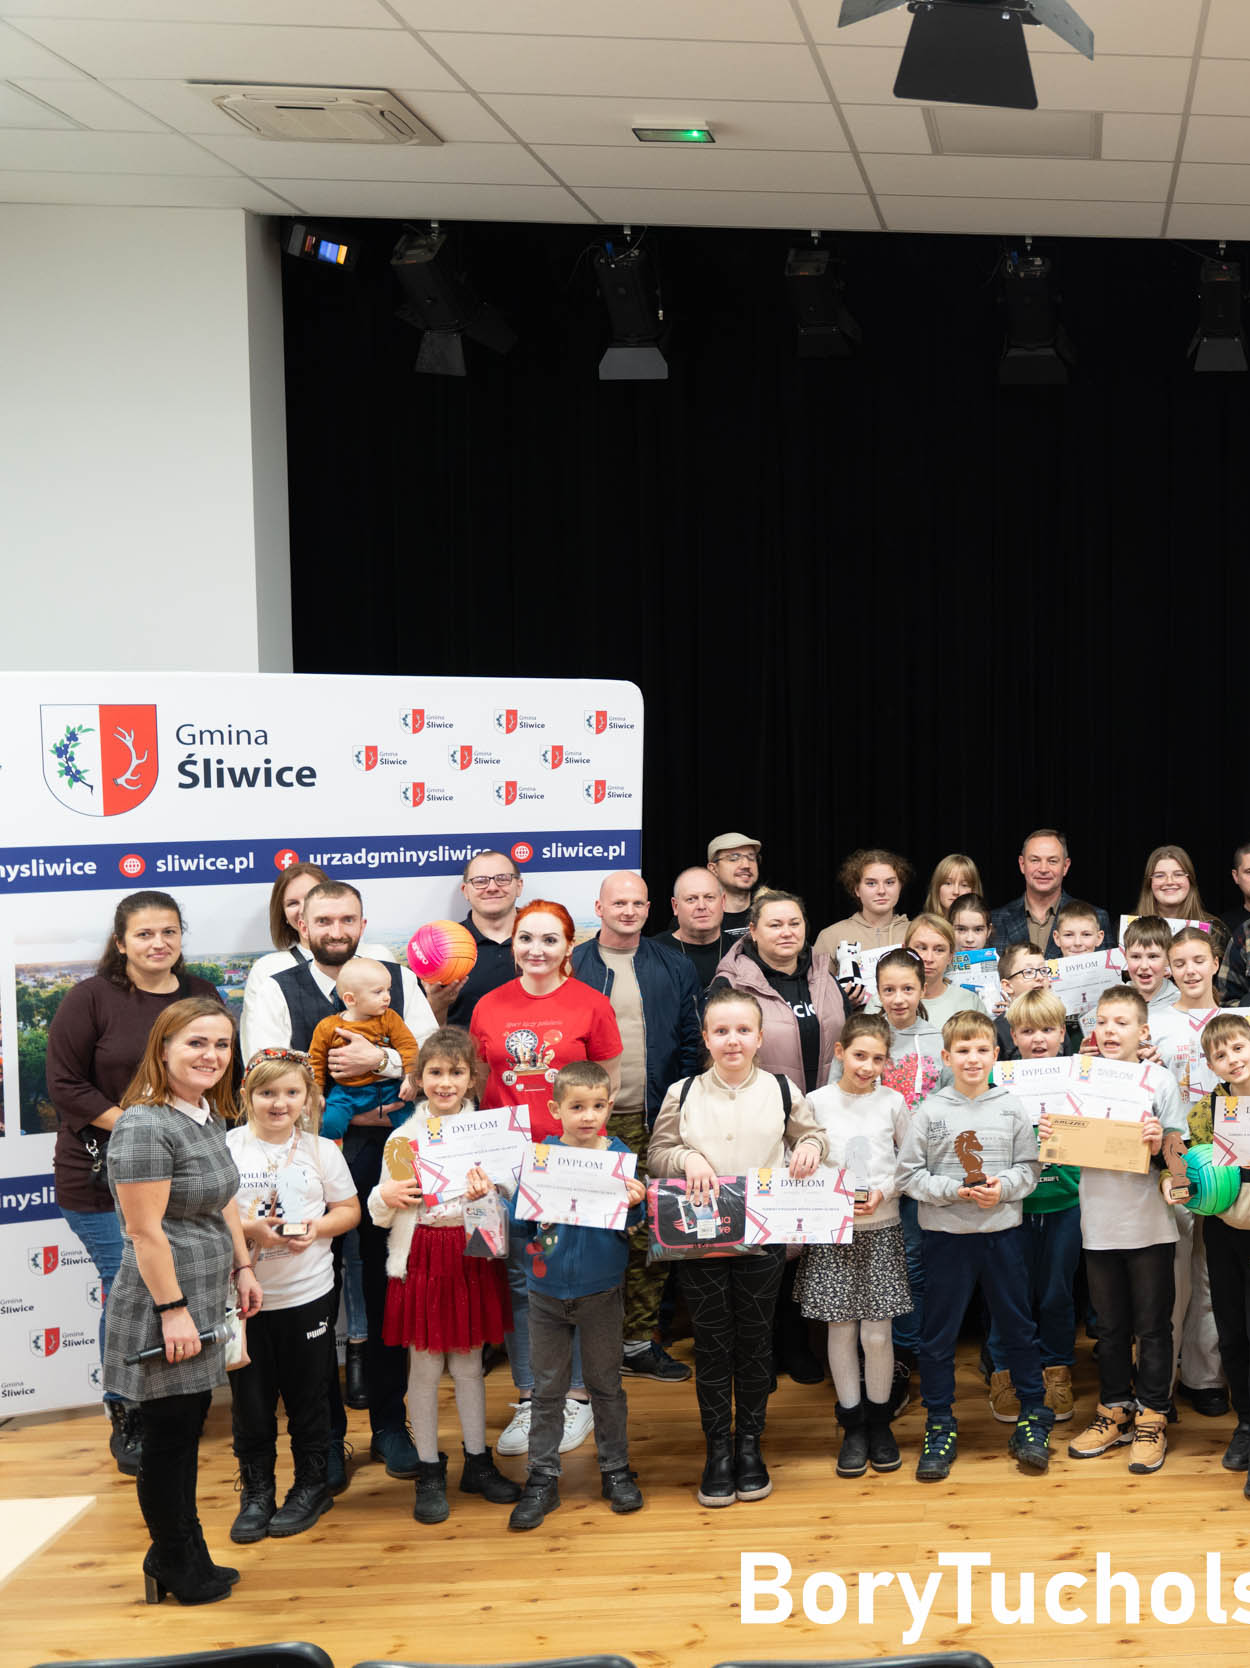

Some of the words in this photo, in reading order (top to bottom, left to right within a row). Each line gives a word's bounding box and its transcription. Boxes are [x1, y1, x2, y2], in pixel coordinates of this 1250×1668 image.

[426, 721, 454, 729] Śliwice
[519, 721, 546, 729] Śliwice
[608, 722, 635, 730] Śliwice
[176, 723, 269, 746] Gmina
[380, 757, 407, 766] Śliwice
[474, 757, 501, 765] Śliwice
[565, 756, 591, 764] Śliwice
[178, 753, 317, 789] Śliwice
[426, 793, 454, 802] Śliwice
[518, 792, 545, 800] Śliwice
[607, 791, 633, 799] Śliwice
[542, 841, 626, 860] sliwice.pl
[309, 845, 492, 868] urzadgminysliwic
[156, 852, 254, 872] sliwice.pl
[1065, 960, 1098, 972] DYPLOM
[1022, 1067, 1061, 1077] DYPLOM
[452, 1120, 498, 1134] DYPLOM
[558, 1157, 604, 1170] DYPLOM
[780, 1178, 825, 1188] DYPLOM
[0, 1304, 34, 1314] Śliwice
[62, 1337, 96, 1348] Śliwice
[1, 1388, 36, 1398] Śliwice
